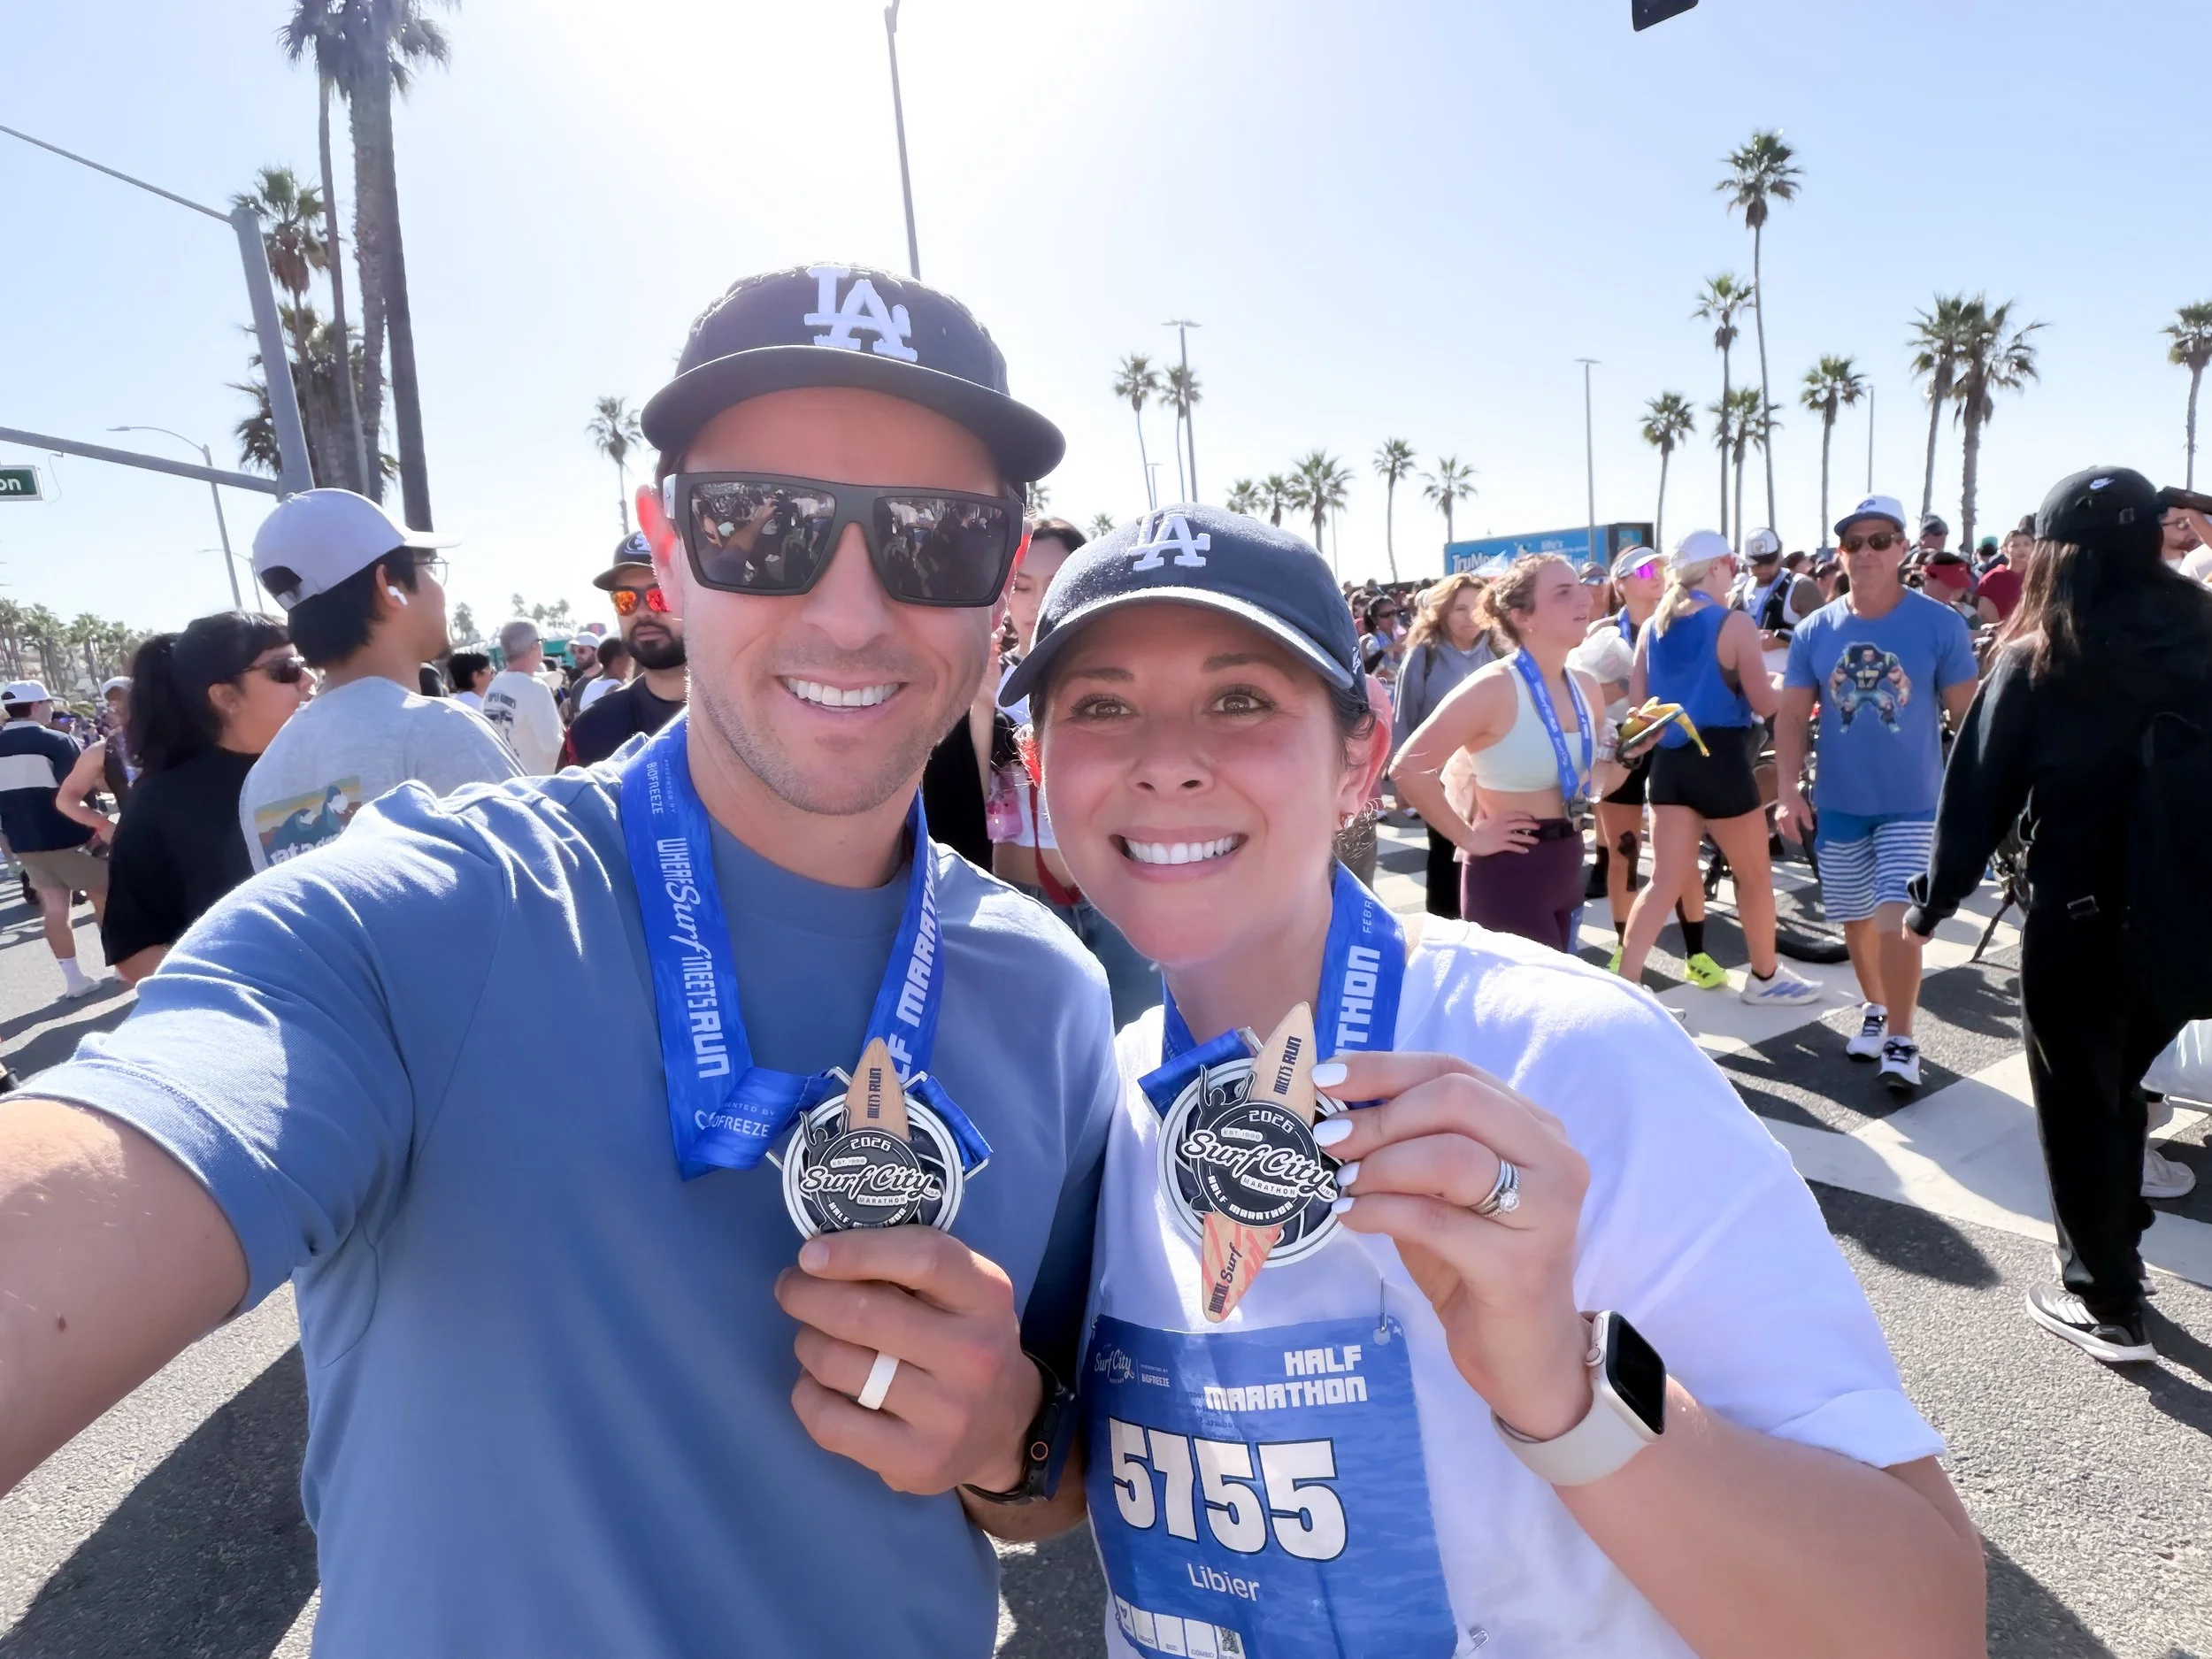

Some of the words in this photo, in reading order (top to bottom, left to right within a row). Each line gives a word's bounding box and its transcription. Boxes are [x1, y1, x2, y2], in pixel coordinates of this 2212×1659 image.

[804, 265, 918, 362] LA
[0, 478, 22, 491] on
[1128, 514, 1210, 572] LA
[646, 761, 664, 815] BIOFREEZE
[657, 838, 695, 886] WHERE
[665, 880, 711, 960] Surf
[895, 858, 936, 1028] MARATH
[681, 954, 718, 1012] MEETS
[1334, 945, 1381, 1055] THON
[688, 1010, 730, 1079] RUN
[1282, 1035, 1302, 1068] RUN
[869, 1067, 882, 1093] RUN
[725, 1102, 757, 1112] ENTED
[762, 1108, 775, 1117] BY
[1248, 1110, 1296, 1134] 2026
[849, 1137, 893, 1151] 2026
[1181, 1130, 1266, 1178] Surf
[1260, 1149, 1334, 1196] City
[800, 1164, 872, 1201] Surf
[870, 1163, 935, 1201] City
[858, 1195, 906, 1204] MARATHON
[1207, 1175, 1228, 1203] HALF
[1229, 1201, 1294, 1220] MARATHON
[1242, 1177, 1295, 1195] MARATHON
[828, 1202, 850, 1223] HALF
[1220, 1241, 1242, 1284] Surf
[1094, 1349, 1115, 1379] Surf
[1112, 1348, 1135, 1379] City
[1284, 1345, 1362, 1377] HALF
[1203, 1376, 1368, 1412] MARATHON
[1109, 1416, 1349, 1563] 5755
[1187, 1562, 1260, 1602] Libier
